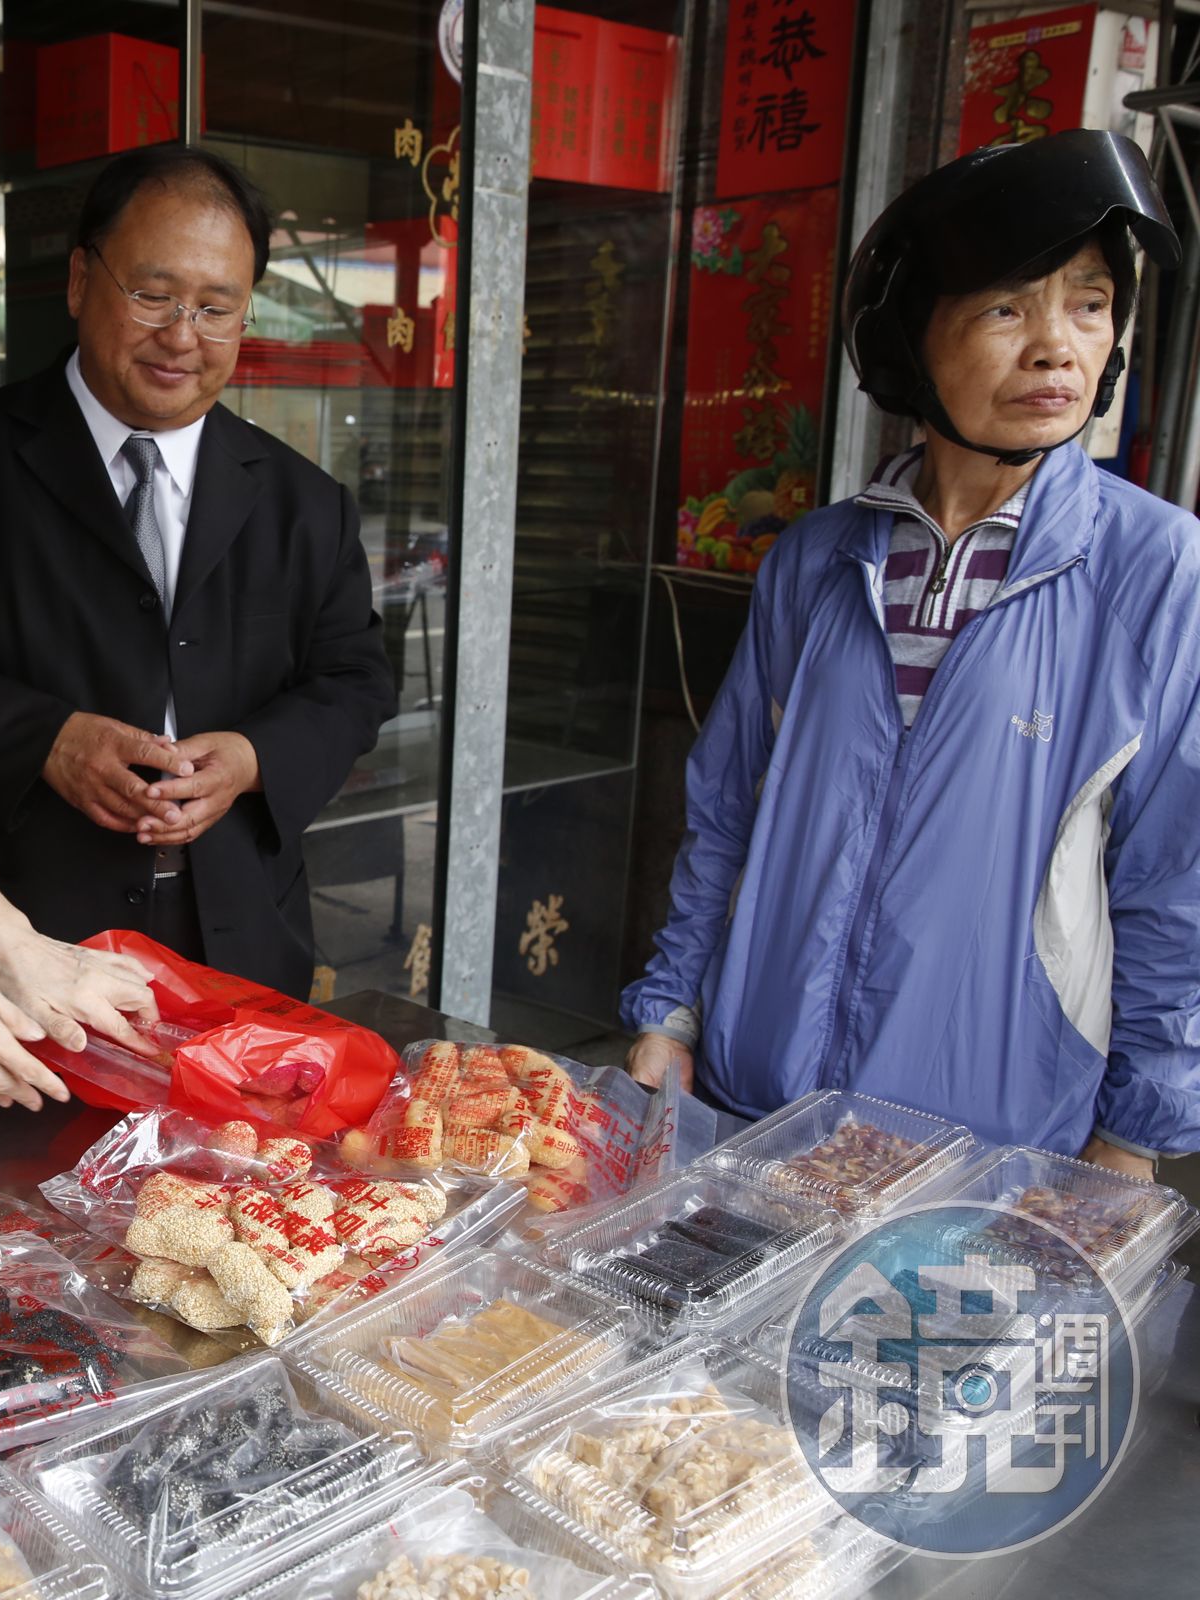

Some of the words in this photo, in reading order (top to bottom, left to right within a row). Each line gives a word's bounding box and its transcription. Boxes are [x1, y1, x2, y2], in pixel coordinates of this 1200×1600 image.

[748, 0, 827, 153] 恭禧
[394, 118, 423, 168] 肉
[386, 307, 416, 353] 肉
[1010, 714, 1038, 731] Snow
[1017, 727, 1035, 739] Fox
